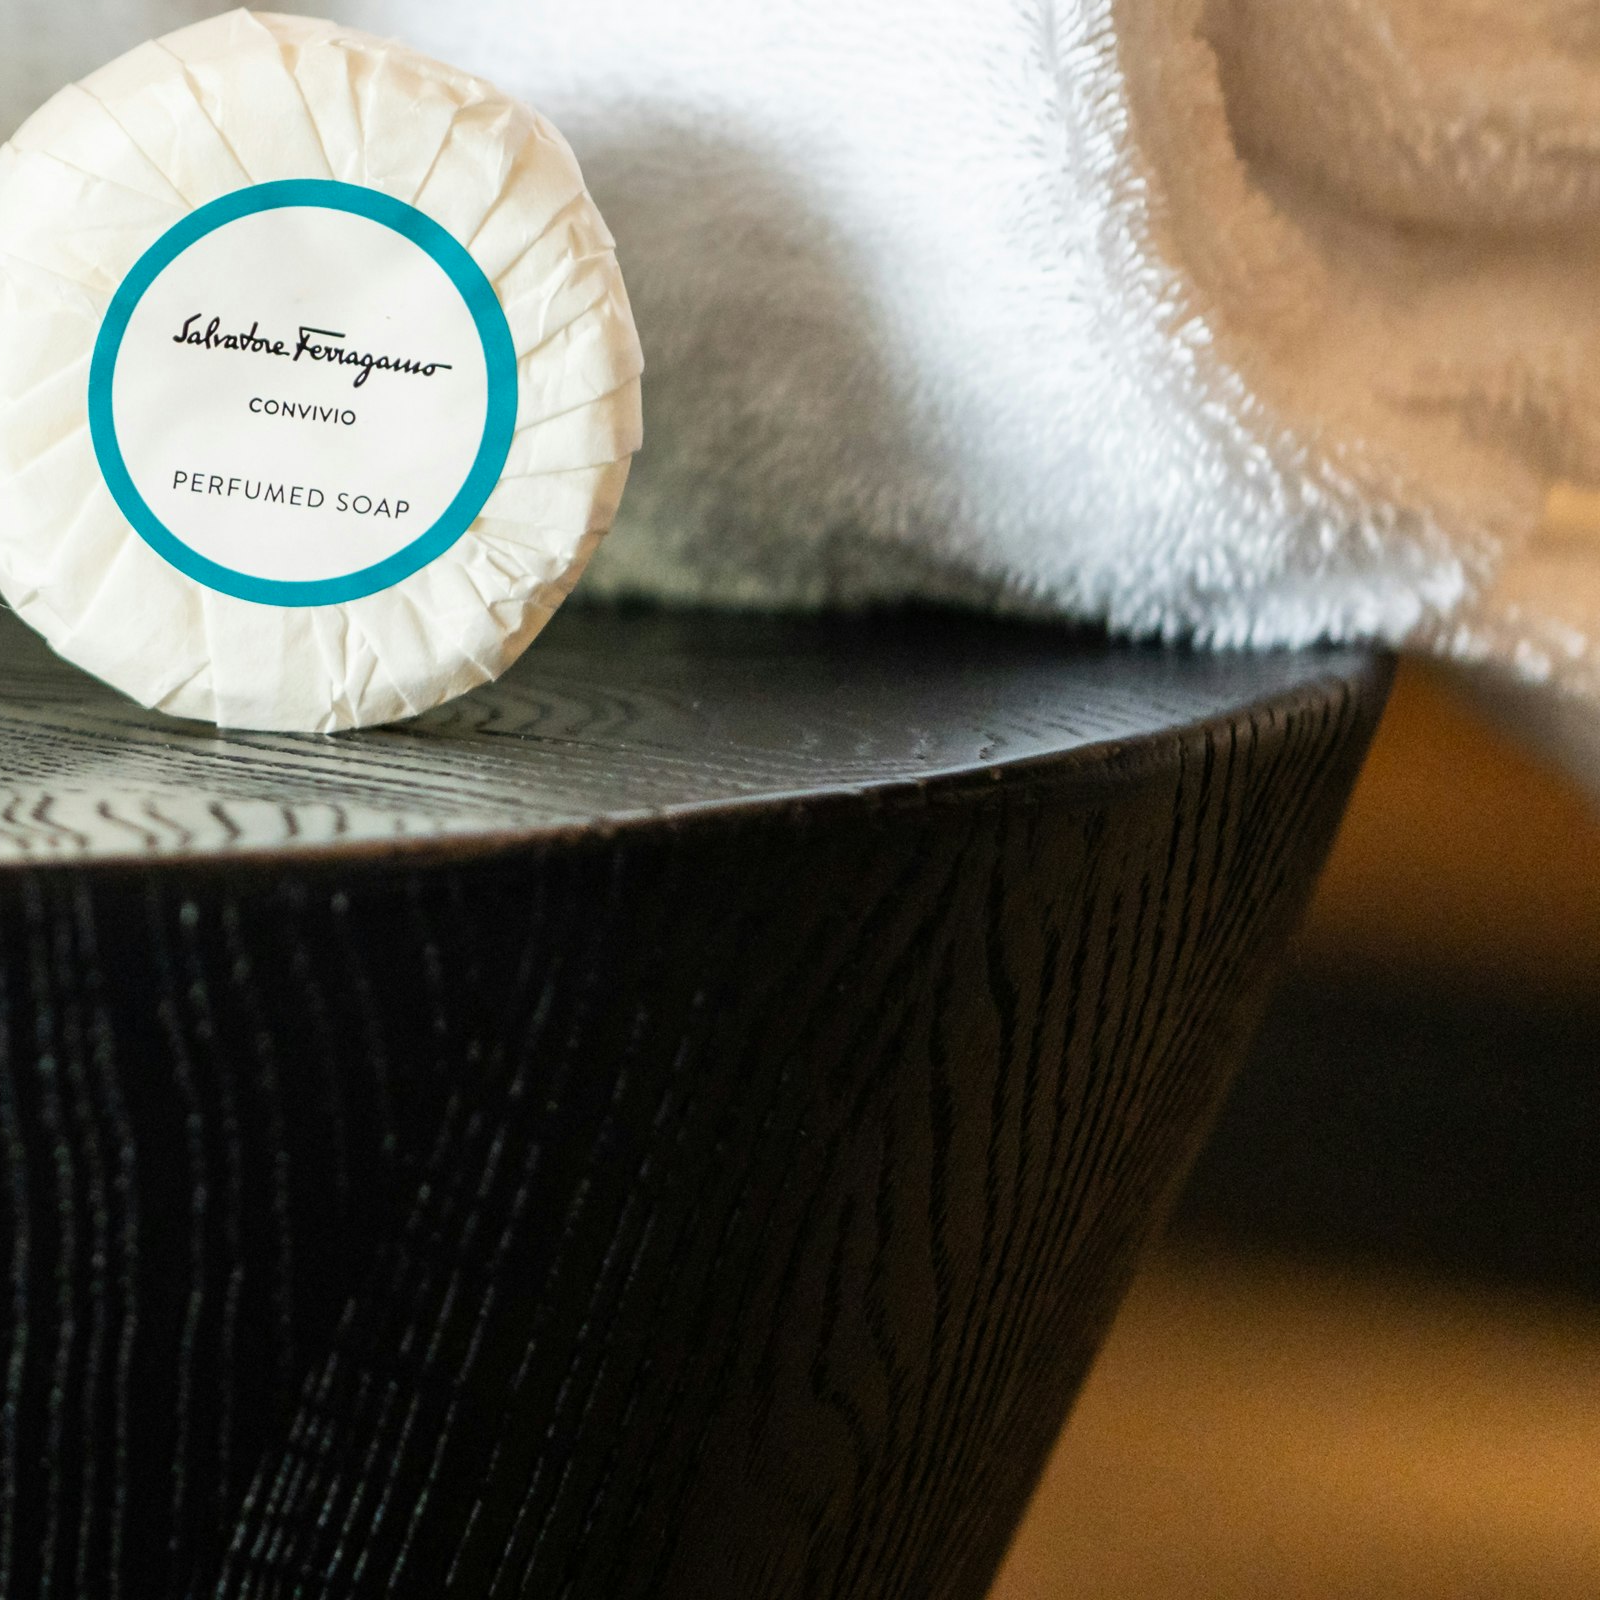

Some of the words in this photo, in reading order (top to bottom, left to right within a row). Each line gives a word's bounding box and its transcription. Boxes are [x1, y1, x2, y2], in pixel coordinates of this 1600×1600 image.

[172, 313, 290, 356] Salvatore
[292, 326, 453, 388] Ferragamo
[249, 397, 356, 426] CONVIVIO
[172, 470, 325, 509] PERFUMED
[336, 491, 410, 519] SOAP
